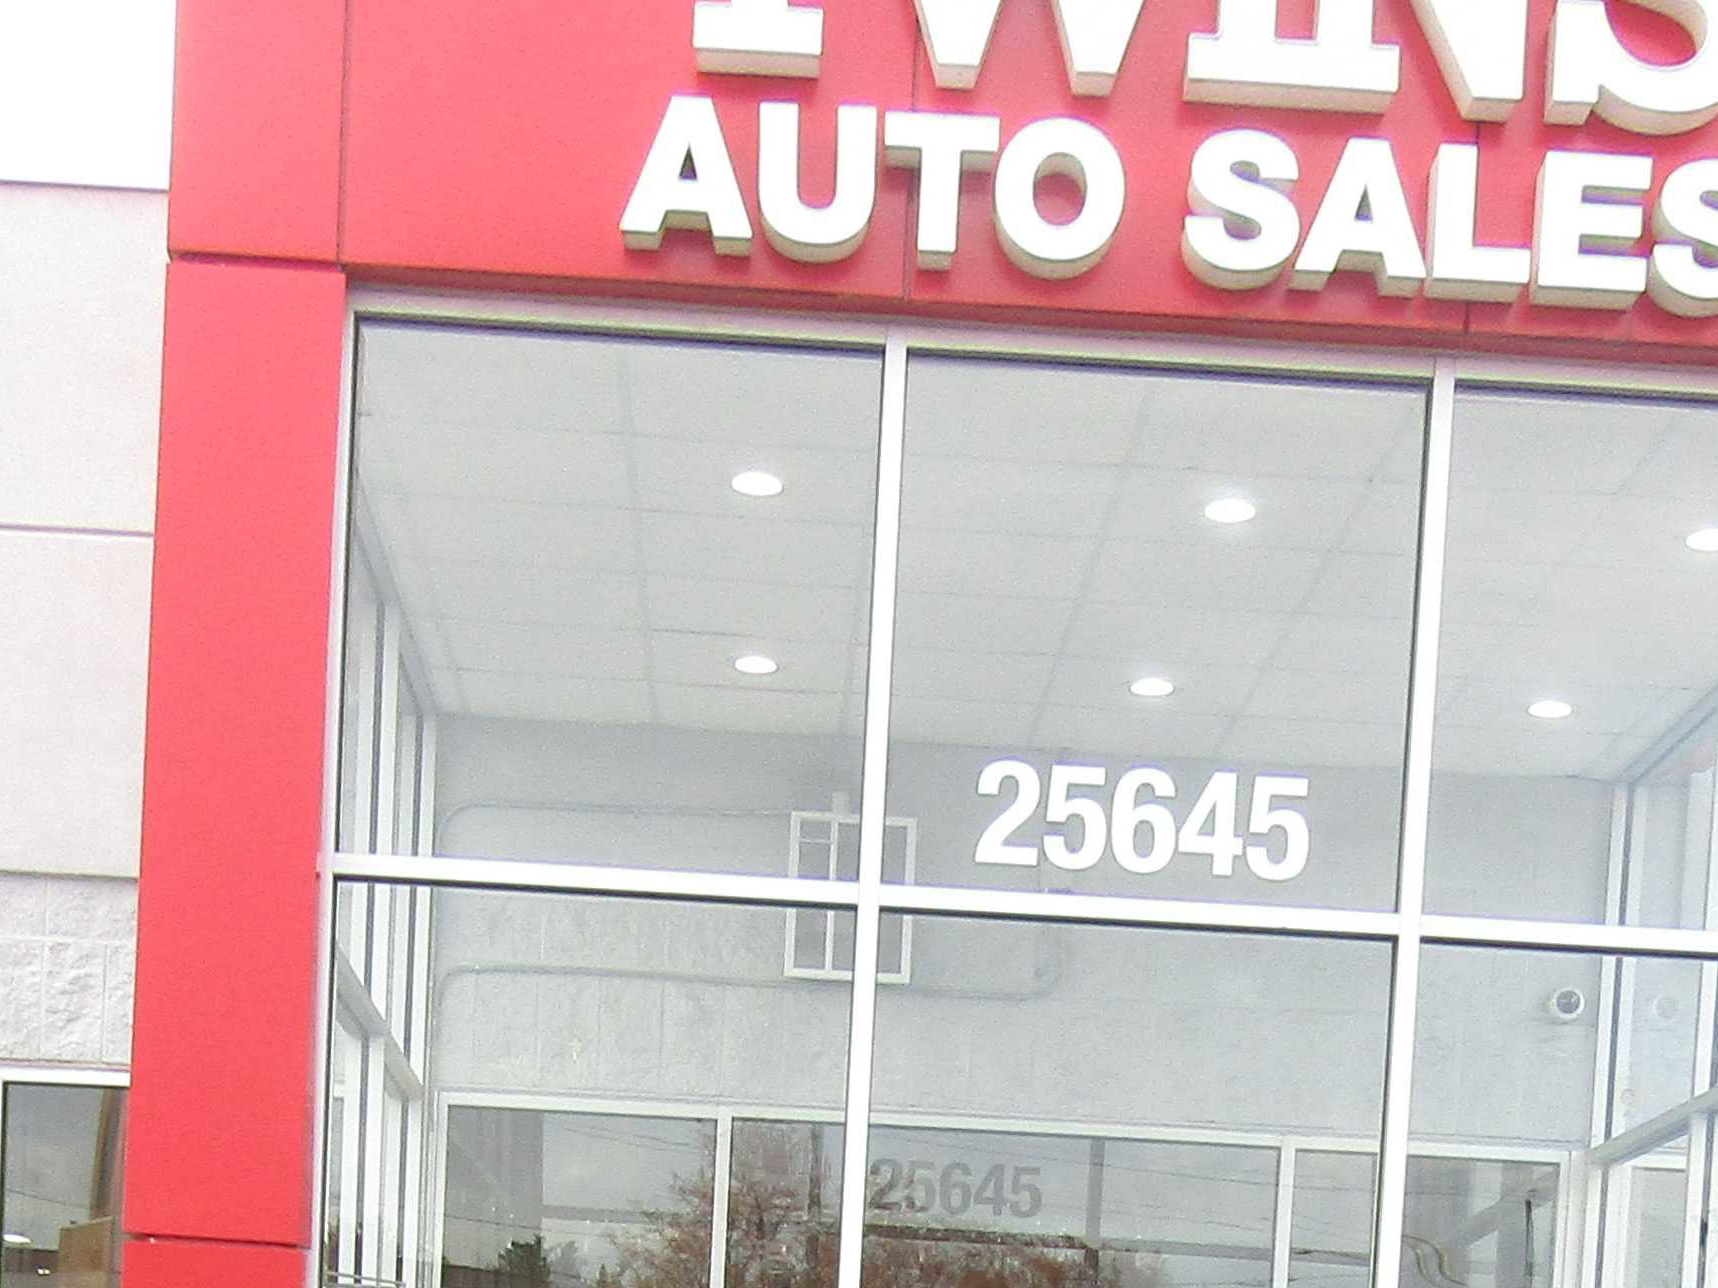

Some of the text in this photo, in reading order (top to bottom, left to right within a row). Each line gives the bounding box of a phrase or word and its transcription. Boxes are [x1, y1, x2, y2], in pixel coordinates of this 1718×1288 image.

[620, 95, 1126, 279] AUTO
[974, 757, 1310, 882] 25645
[868, 1157, 1043, 1219] 25645
